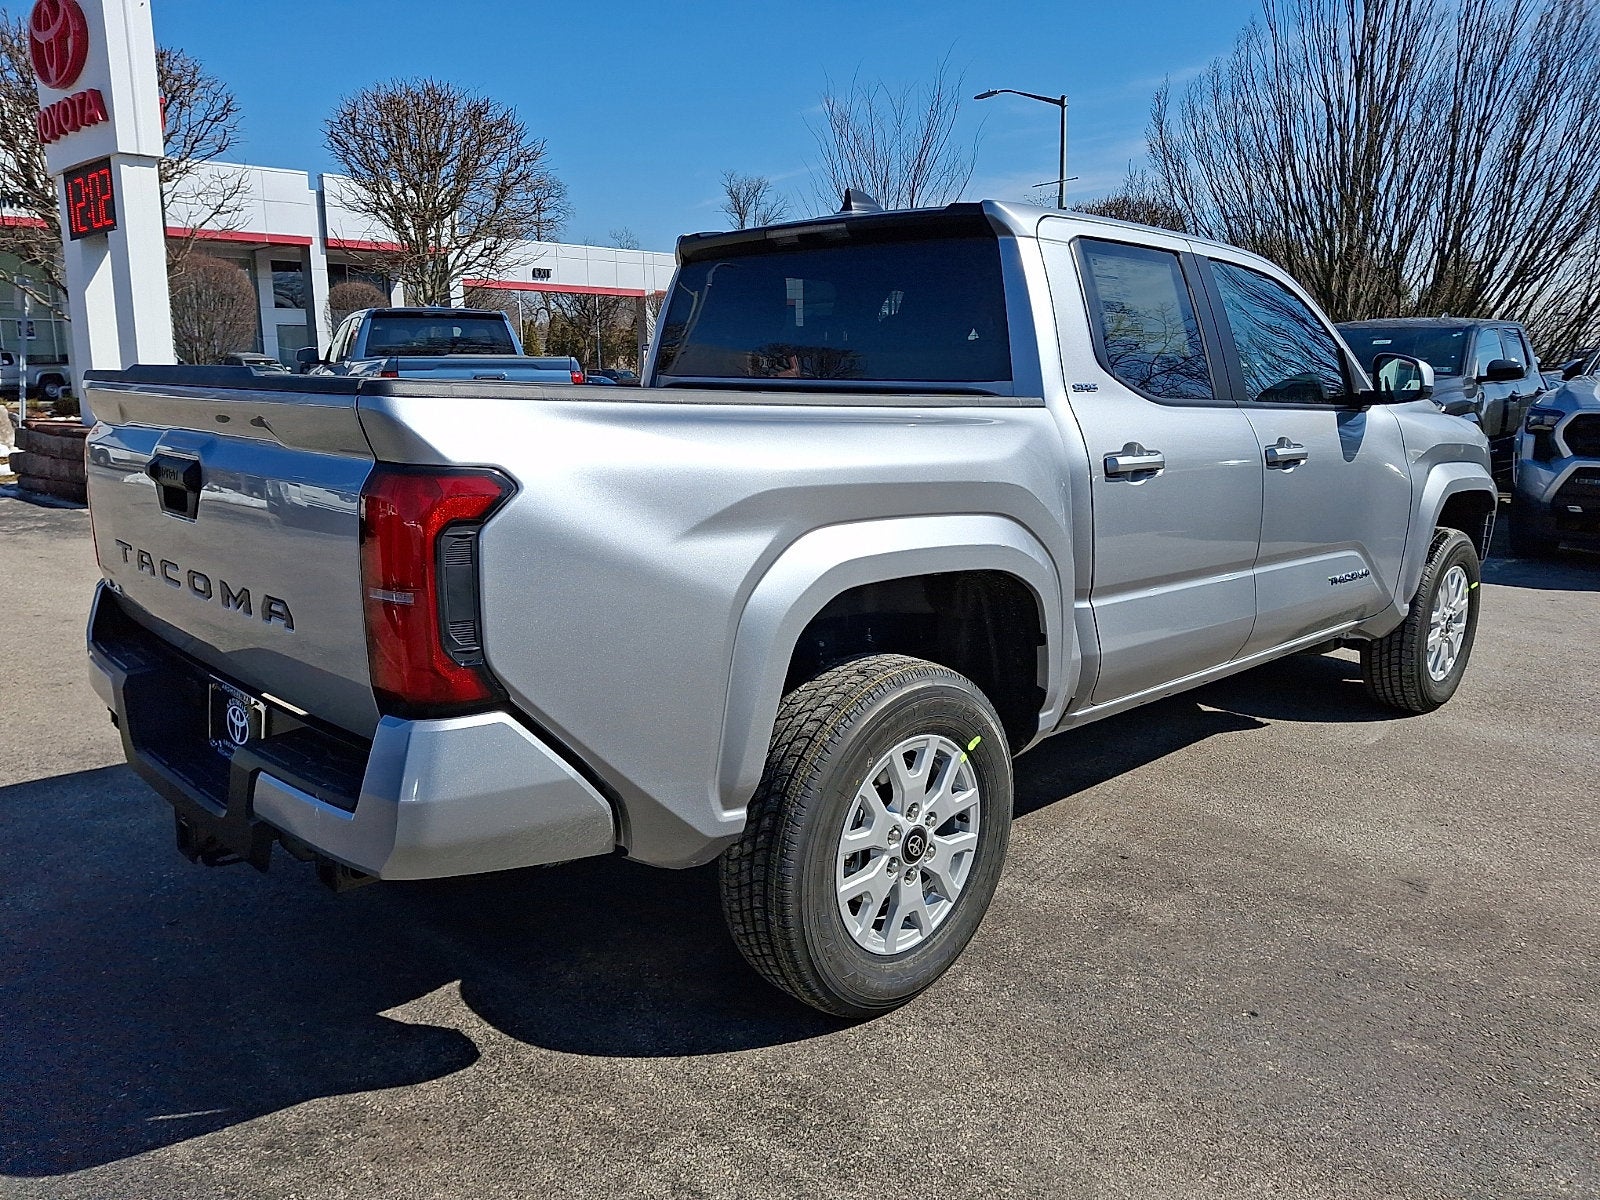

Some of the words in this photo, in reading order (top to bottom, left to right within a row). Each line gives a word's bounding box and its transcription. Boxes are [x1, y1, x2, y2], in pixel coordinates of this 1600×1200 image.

[37, 88, 110, 144] TOYOTA
[67, 167, 115, 234] 12:02
[115, 538, 296, 633] TACOMA
